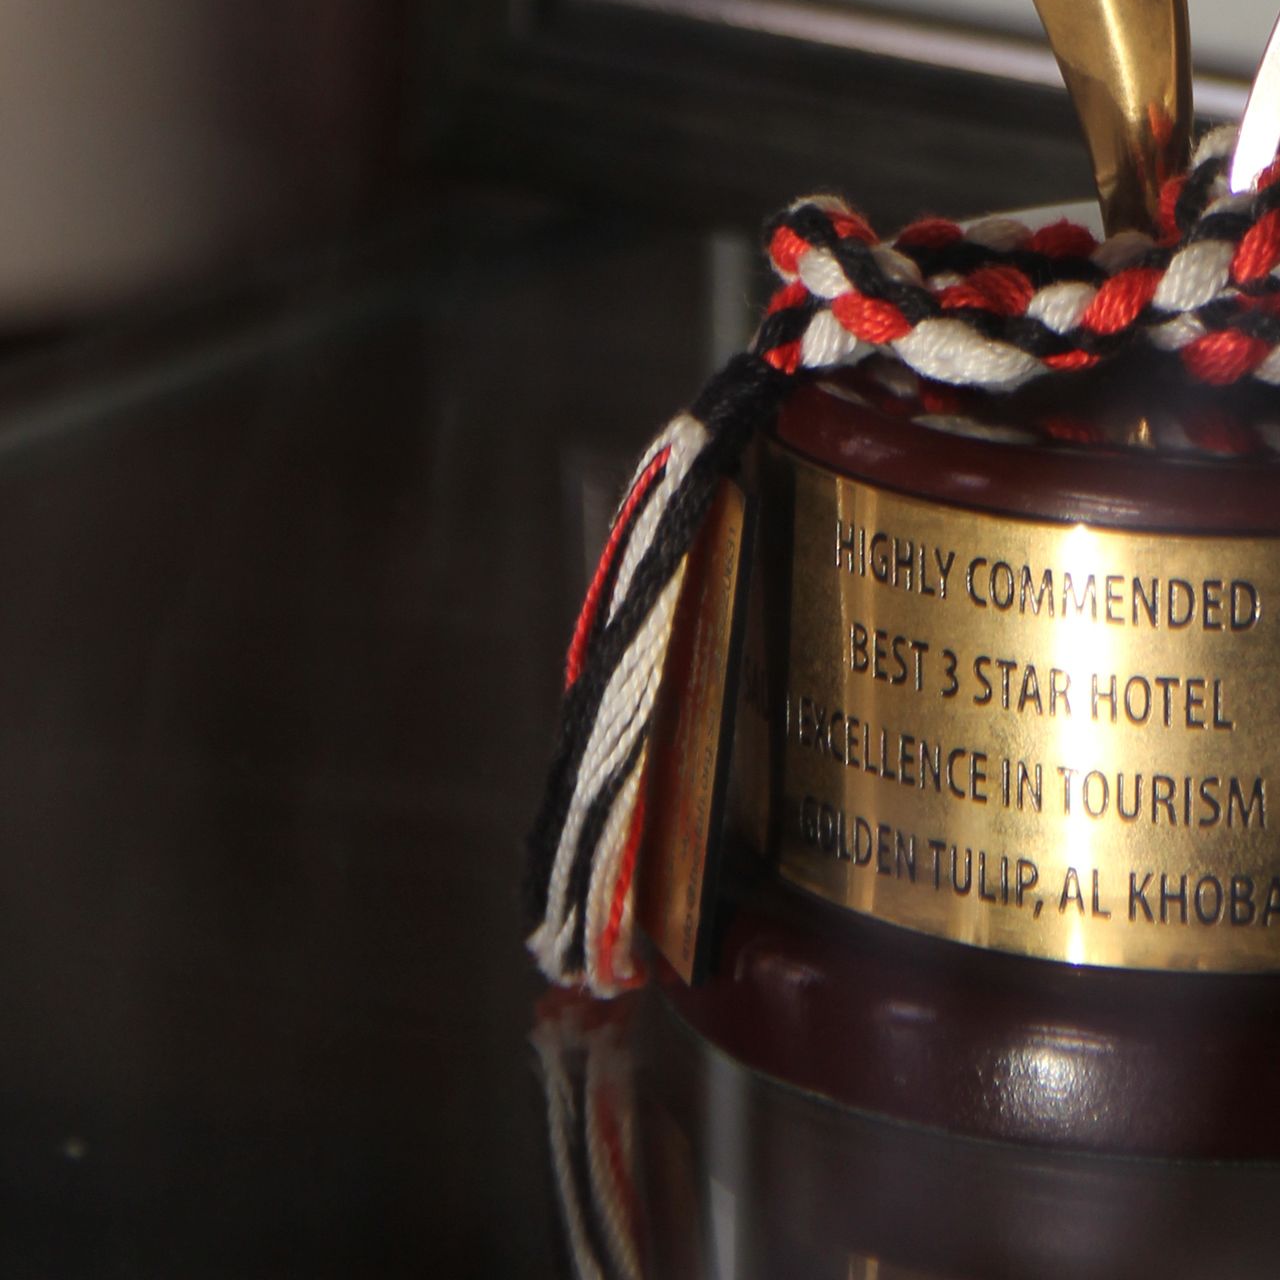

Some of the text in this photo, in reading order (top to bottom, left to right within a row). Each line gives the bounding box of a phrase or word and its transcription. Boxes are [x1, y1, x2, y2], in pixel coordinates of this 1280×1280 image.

[834, 519, 1262, 633] HIGHLY COMMENDED
[850, 621, 1237, 732] BEST 3 STAR HOTEL
[798, 694, 989, 806] EXCELLENCE
[1001, 757, 1043, 814] IN
[1057, 765, 1268, 830] TOURISM
[799, 794, 917, 886] GOLDEN
[928, 837, 1046, 921] TULIP,
[1058, 865, 1112, 922] AL
